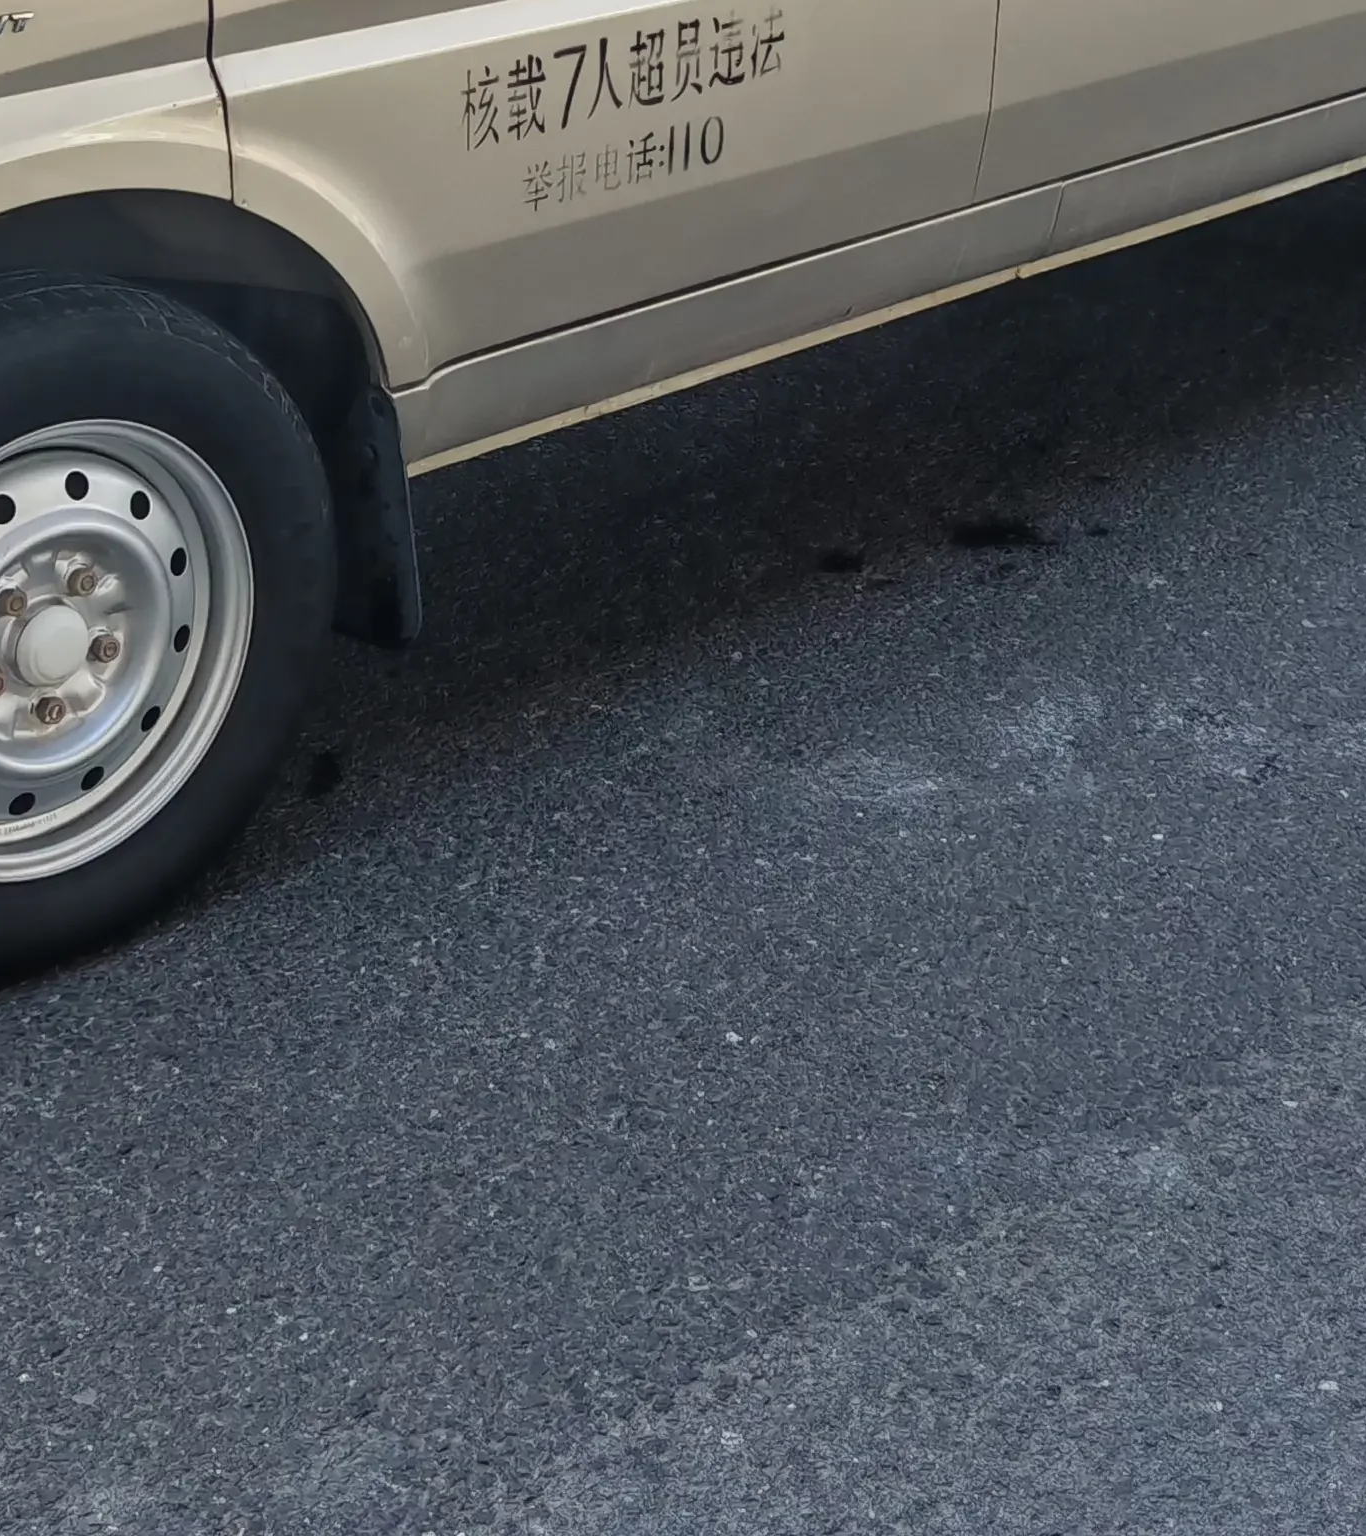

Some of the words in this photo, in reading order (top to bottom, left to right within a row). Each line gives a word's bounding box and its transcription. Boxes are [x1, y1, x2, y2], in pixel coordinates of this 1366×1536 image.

[459, 5, 786, 151] 核载7人超员违法
